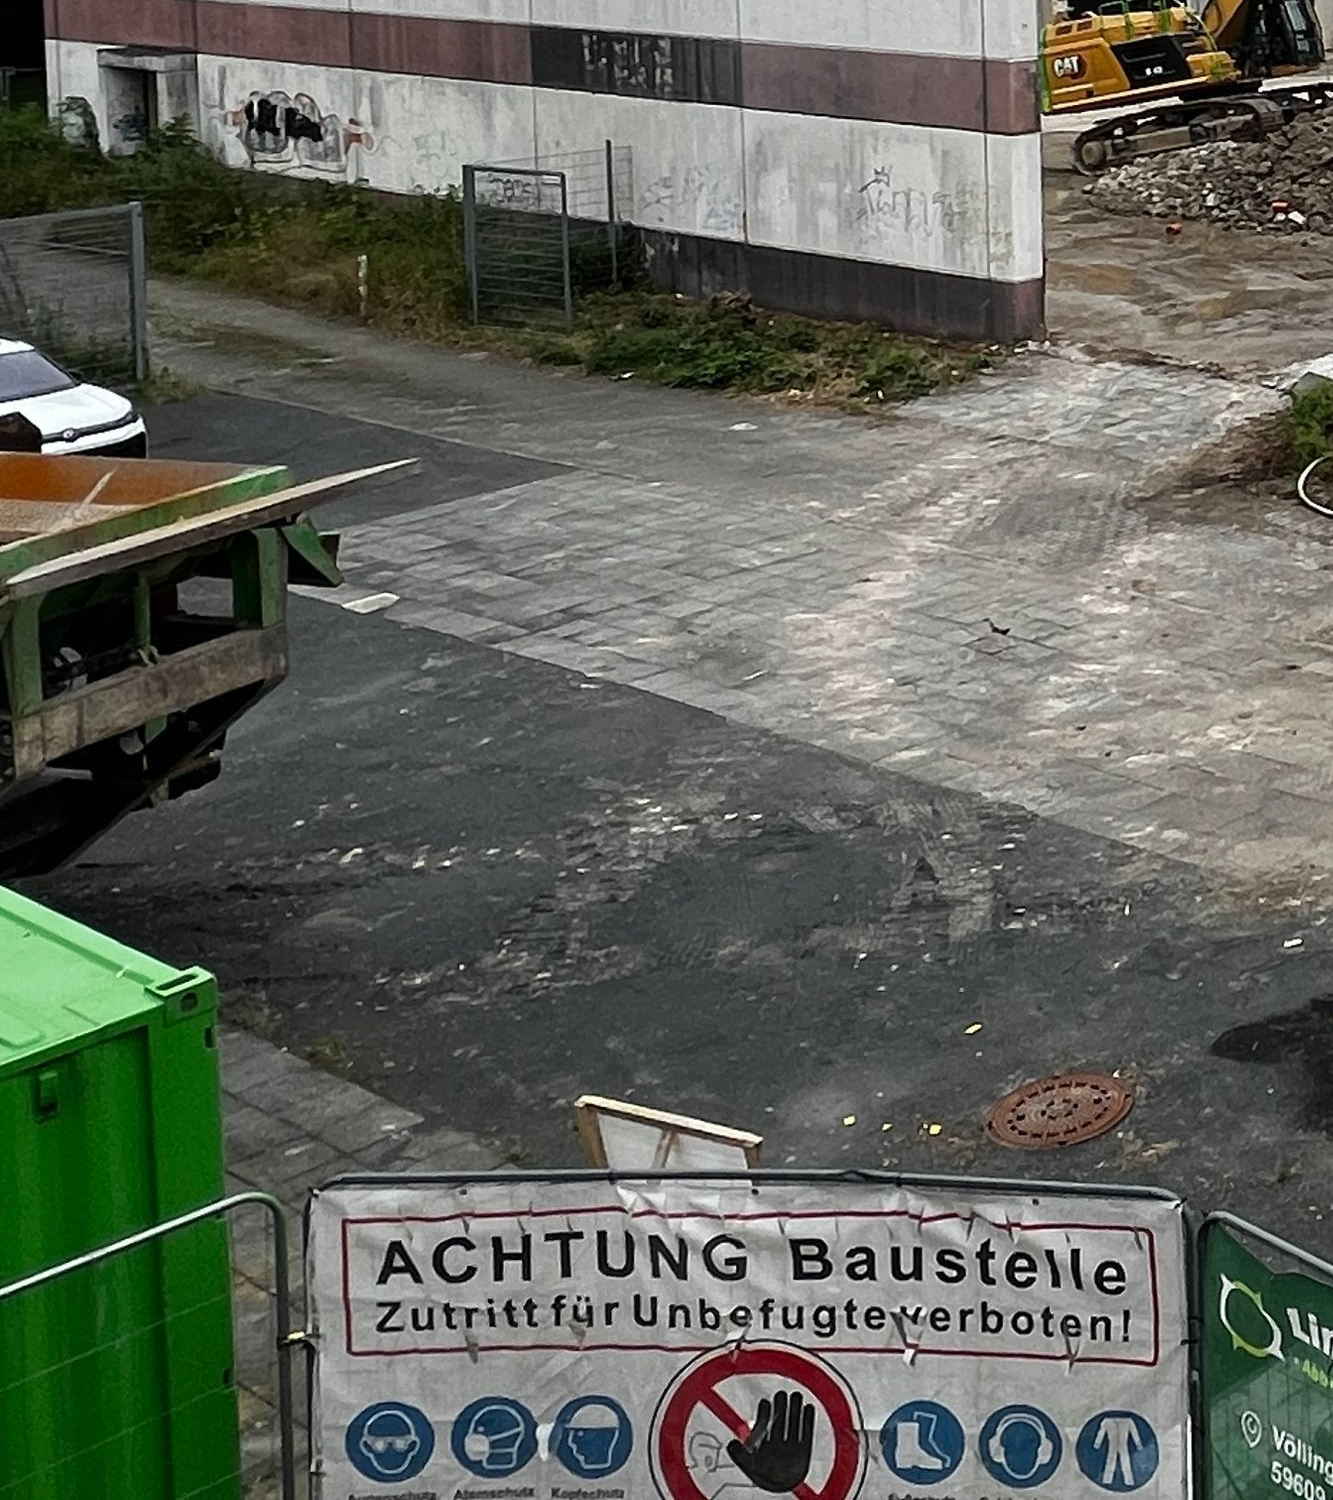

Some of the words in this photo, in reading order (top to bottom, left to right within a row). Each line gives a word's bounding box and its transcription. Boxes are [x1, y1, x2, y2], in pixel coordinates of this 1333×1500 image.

[1054, 55, 1079, 77] CAT
[376, 1230, 748, 1285] ACHTUNG
[789, 1238, 1127, 1296] Baustelle
[376, 1298, 539, 1333] Zutritt
[551, 1295, 619, 1328] für
